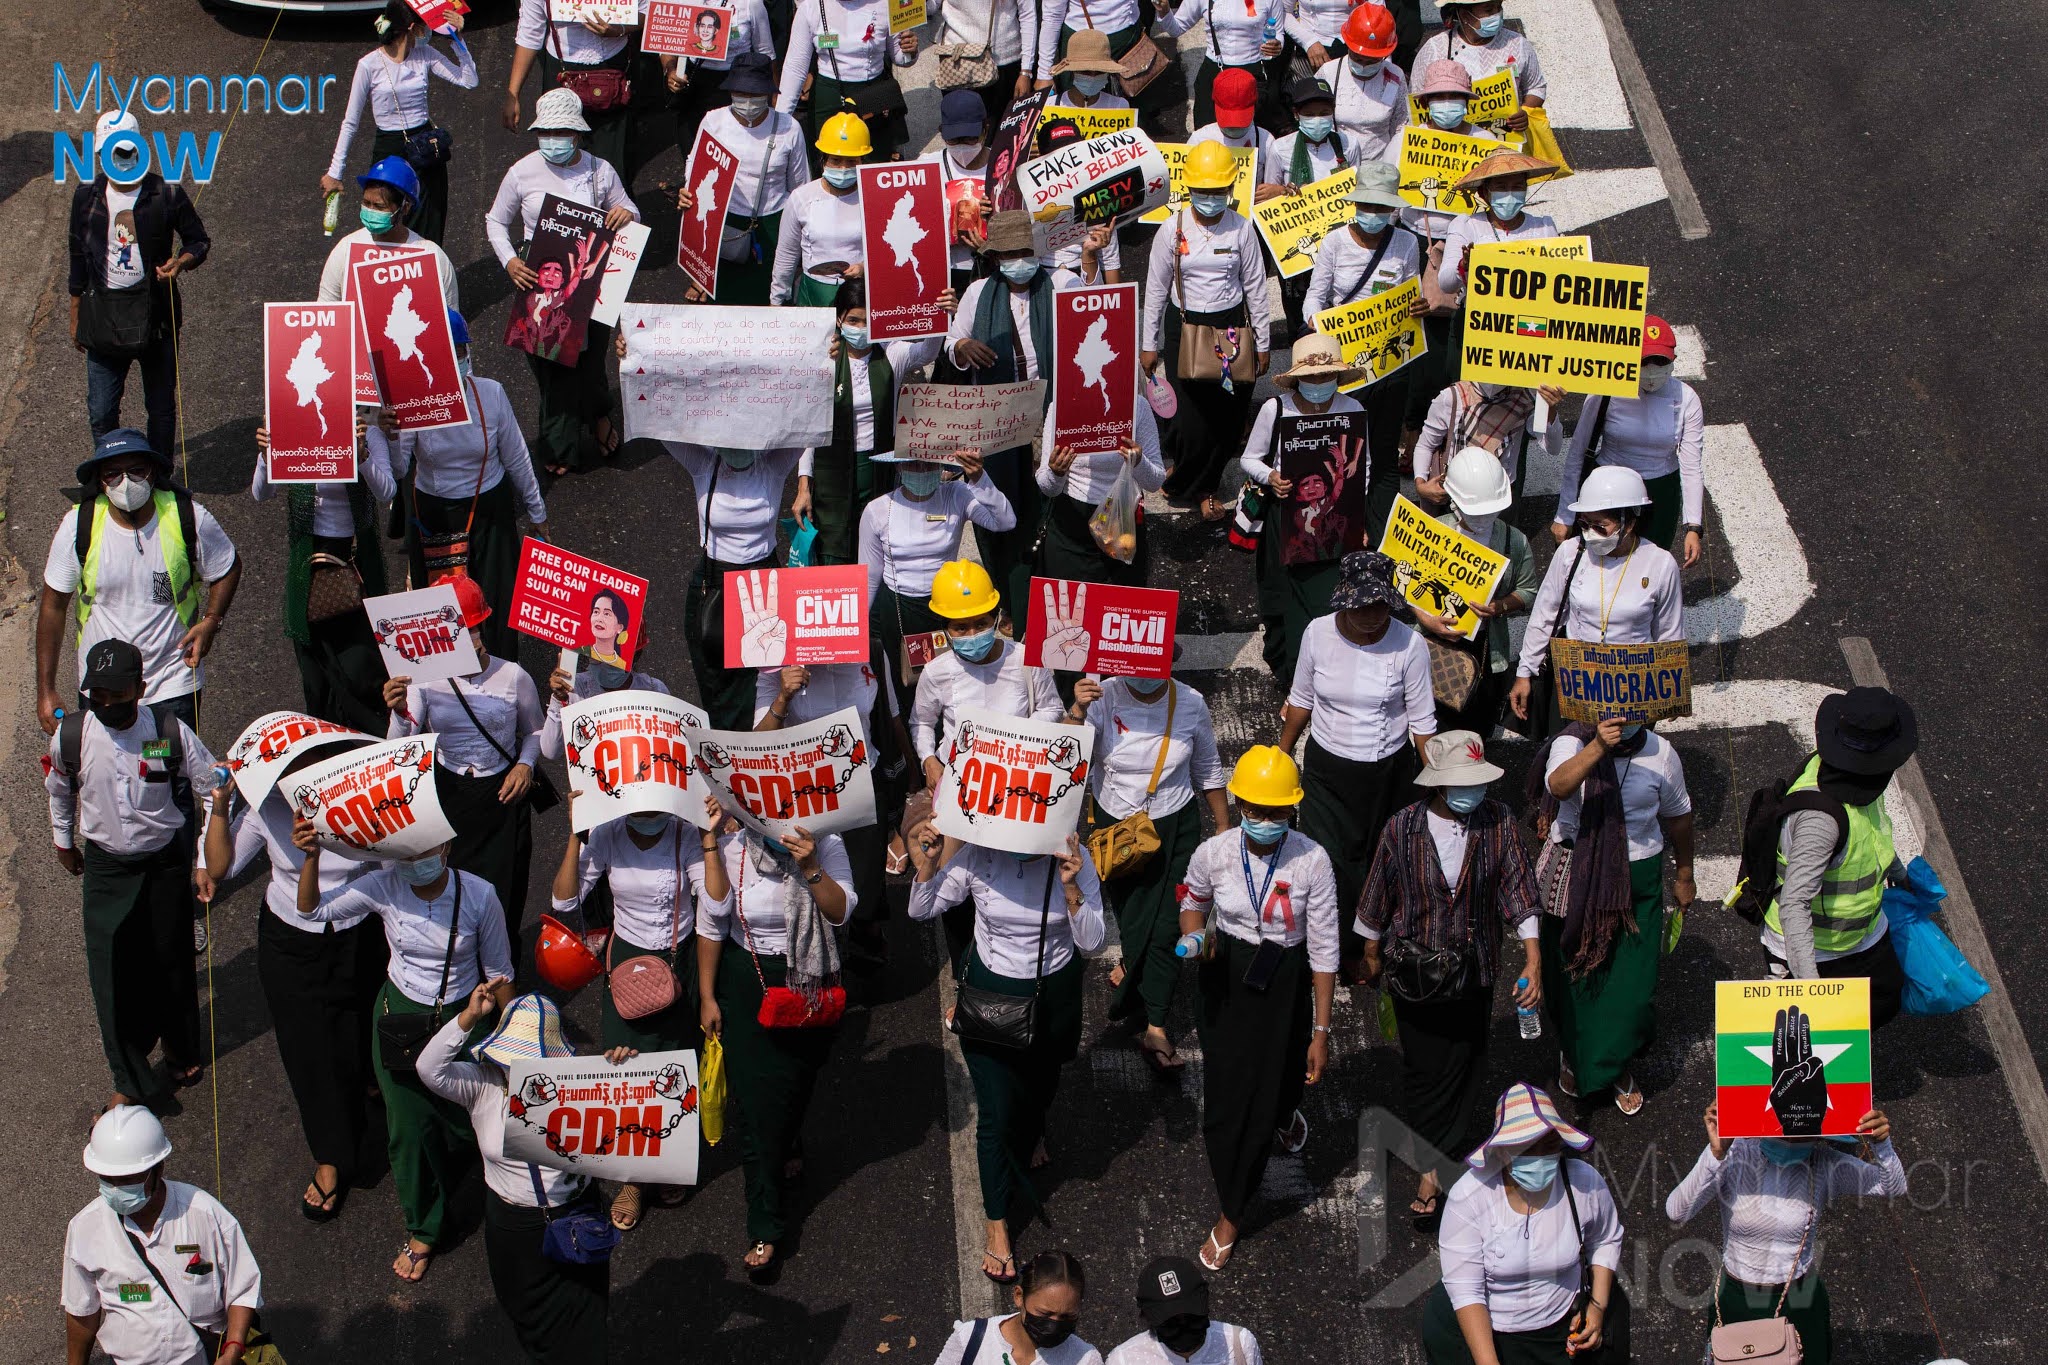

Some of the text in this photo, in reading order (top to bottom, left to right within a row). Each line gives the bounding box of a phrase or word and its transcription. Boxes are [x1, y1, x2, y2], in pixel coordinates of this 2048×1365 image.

[653, 5, 692, 18] ALL IN
[653, 17, 674, 25] FIGHT
[893, 6, 922, 21] OUR VOTES
[651, 25, 688, 34] DEMOCRACY
[664, 37, 688, 45] WANT
[1476, 78, 1511, 98] Accept
[1480, 94, 1512, 112] COUP
[1051, 127, 1075, 137] Supreme
[1408, 134, 1466, 155] We Don't
[706, 141, 731, 171] CDM
[1028, 131, 1135, 187] FAKE NEWS
[1407, 151, 1469, 172] MILITARY
[877, 169, 926, 188] CDM
[1033, 142, 1148, 205] DON'T BELIEVE
[1081, 177, 1132, 208] MRTV
[1259, 177, 1357, 221] We Don't Accept
[1084, 195, 1133, 222] MWD
[1269, 206, 1325, 236] MILITARY
[109, 268, 125, 277] Marry
[373, 261, 423, 284] CDM
[1474, 265, 1644, 311] STOP CRIME
[1072, 293, 1120, 312] CDM
[1322, 286, 1417, 331] We Don't Accept
[284, 311, 335, 327] CDM
[651, 316, 815, 333] The only you do not own
[1470, 311, 1641, 347] SAVE MYANMAR
[654, 333, 671, 345] the
[790, 334, 806, 344] the
[654, 348, 692, 360] people,
[735, 345, 751, 357] the
[653, 367, 666, 376] It
[677, 367, 684, 375] is
[718, 365, 740, 378] just
[751, 367, 782, 375] about
[1466, 346, 1637, 382] WE WANT JUSTICE
[654, 378, 672, 387] but
[682, 378, 691, 388] it
[719, 377, 750, 388] about
[911, 381, 1036, 397] We don't want
[653, 391, 819, 410] Give back the country to
[656, 406, 672, 415] its
[912, 398, 1008, 411] Dictatorship.
[911, 413, 1027, 429] We must fight
[909, 428, 930, 439] for
[909, 436, 1016, 452] education and
[1397, 506, 1497, 576] We Don't Accept
[1393, 524, 1486, 589] MILITARY COUP
[529, 563, 586, 592] AUNG SAN
[531, 548, 639, 596] FREE OUR LEADER
[526, 578, 571, 602] SUU KYI
[520, 602, 581, 635] REJECT
[796, 594, 858, 625] Civil
[518, 619, 575, 646] MILITARY COUP
[795, 626, 859, 638] Disobedience
[396, 626, 455, 659] CDM
[1560, 667, 1683, 703] DEMOCRACY
[594, 705, 681, 718] CIVIL DISOBEDIENCE MOVEMENT
[594, 736, 687, 792] CDM
[729, 764, 839, 819] CDM
[957, 757, 1052, 824] CDM
[326, 775, 416, 849] CDM
[1744, 984, 1844, 998] END THE COUP
[577, 1072, 622, 1080] DISOBEDIENCE
[1778, 1070, 1804, 1097] Solidarity
[1790, 1103, 1805, 1111] Hope
[546, 1105, 662, 1157] CDM
[121, 1284, 147, 1293] CDM
